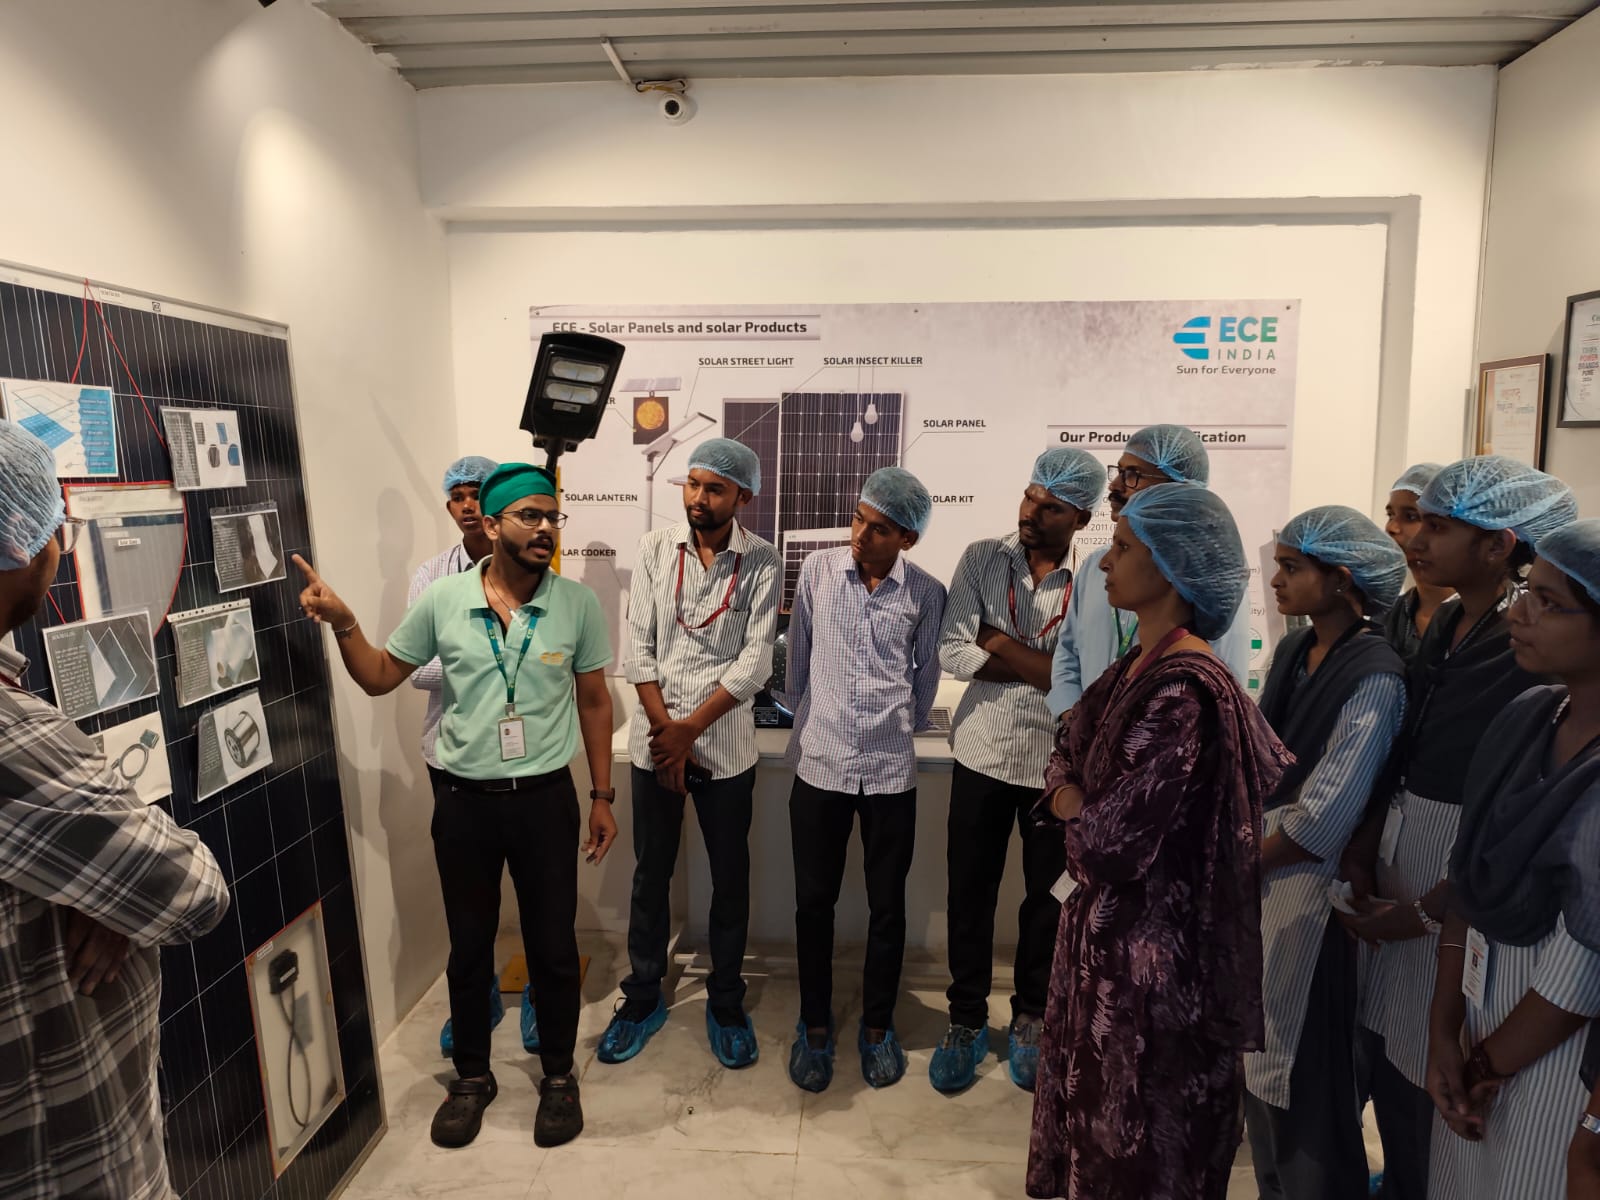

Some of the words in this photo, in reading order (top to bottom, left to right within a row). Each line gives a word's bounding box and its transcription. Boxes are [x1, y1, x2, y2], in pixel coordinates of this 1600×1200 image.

[552, 322, 577, 333] ECE
[588, 321, 625, 334] Solar
[628, 321, 675, 334] Panels
[677, 321, 703, 333] and
[706, 321, 742, 334] solar
[745, 321, 808, 333] Products
[1218, 316, 1279, 343] ECE
[1217, 348, 1276, 361] INDIA
[698, 357, 729, 366] SOLAR
[730, 357, 766, 366] STREET
[767, 357, 795, 366] LIGHT
[823, 356, 854, 365] SOLAR
[855, 356, 889, 365] INSECT
[890, 356, 923, 365] KILLER
[1176, 365, 1199, 375] Sun
[1201, 365, 1219, 375] for
[1221, 365, 1277, 376] Everyone
[923, 419, 954, 428] SOLAR
[955, 419, 987, 428] PANEL
[1060, 431, 1085, 443] Our
[1088, 431, 1131, 443] Produ
[564, 493, 594, 502] SOLAR
[596, 493, 638, 502] LANTERN
[930, 495, 957, 503] OLAR
[959, 495, 975, 503] KIT
[561, 548, 579, 557] LAR
[581, 548, 617, 557] COOKER
